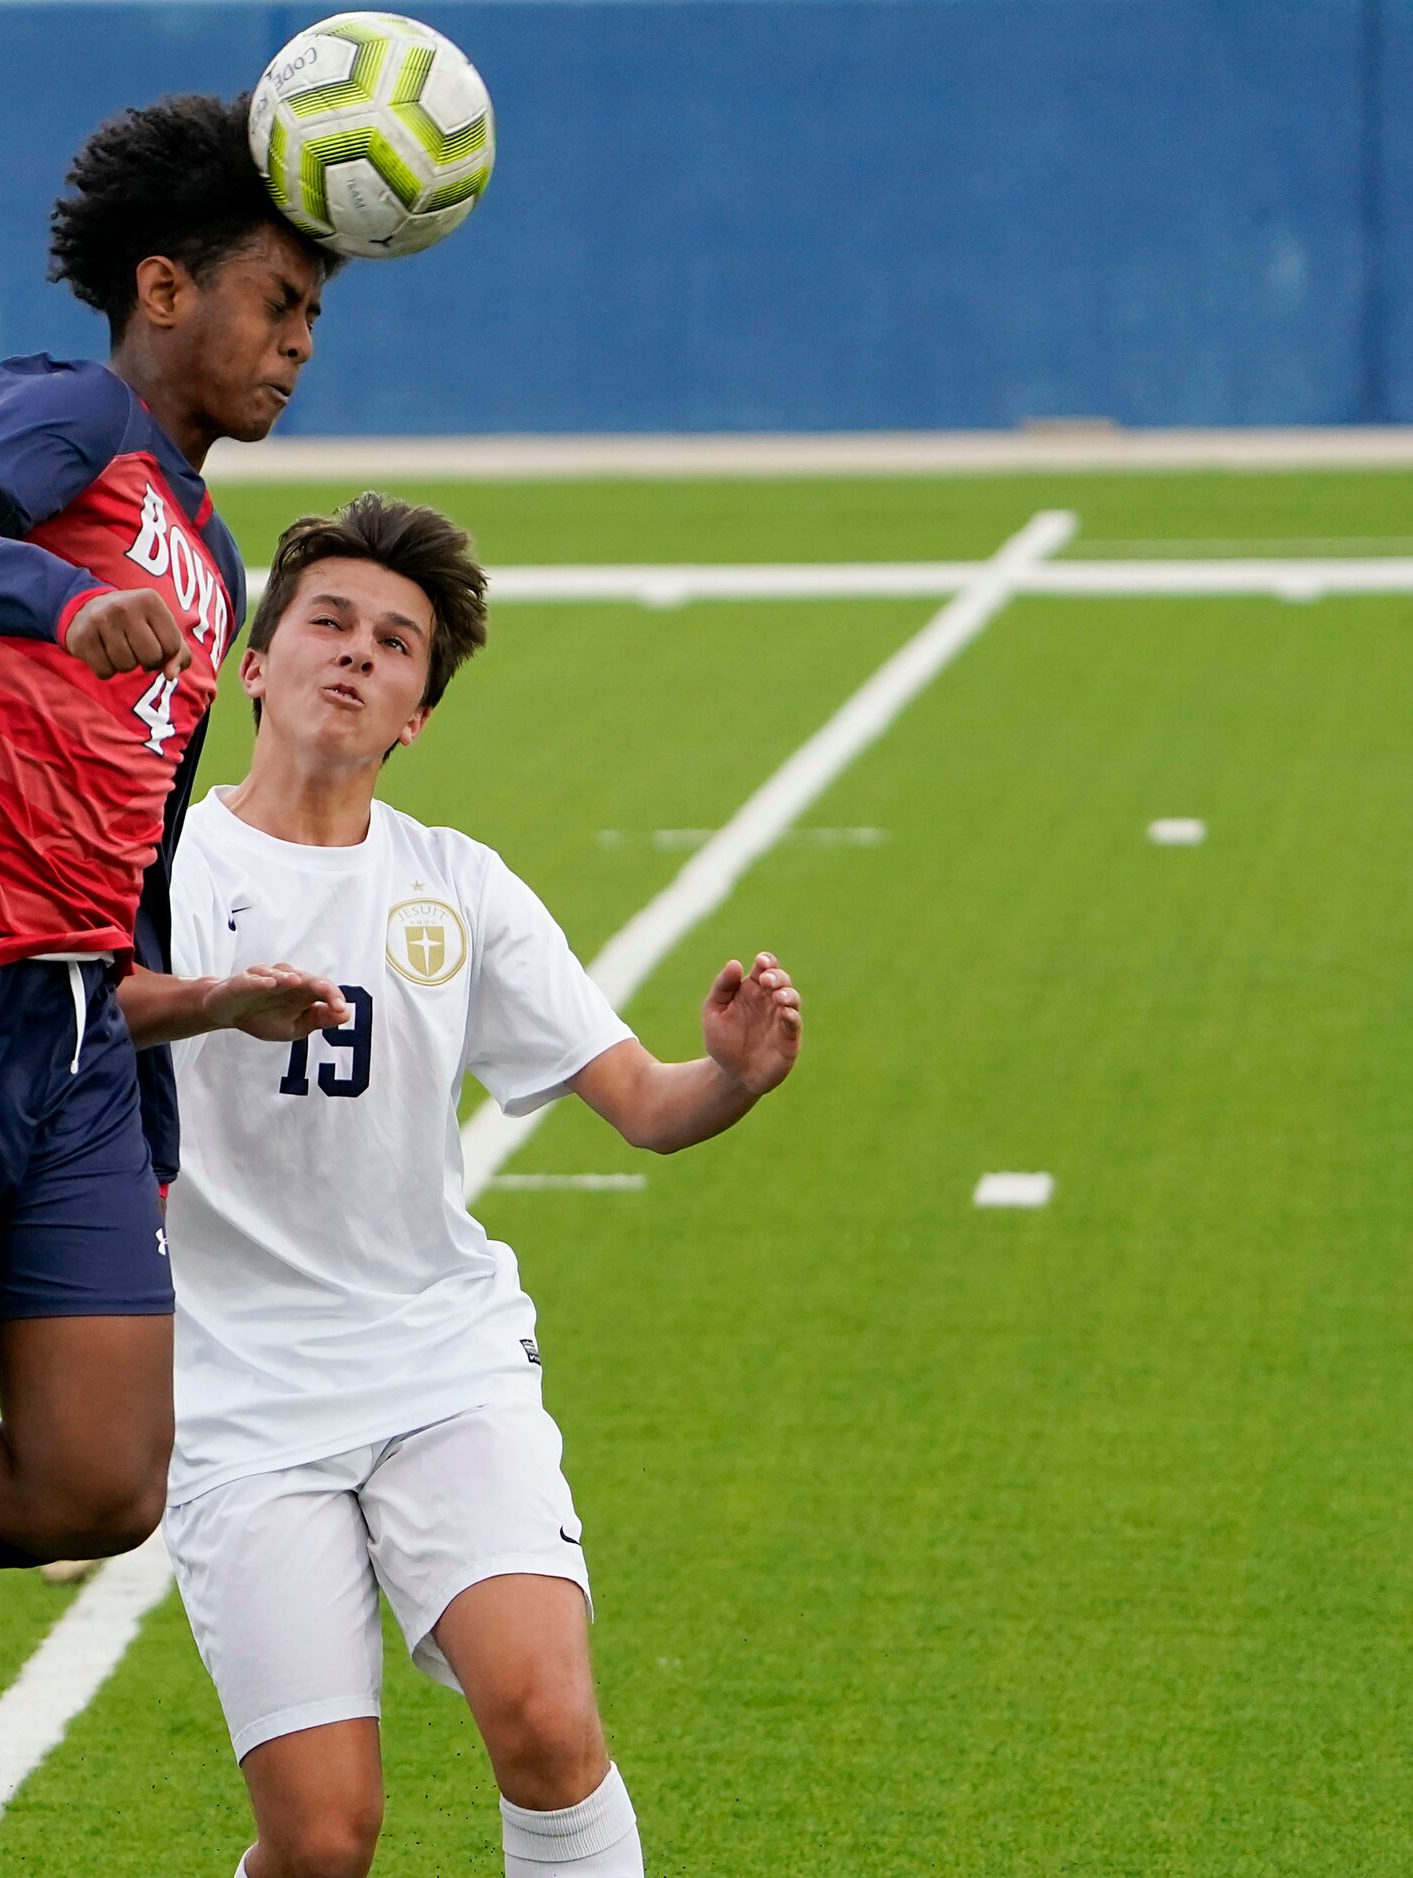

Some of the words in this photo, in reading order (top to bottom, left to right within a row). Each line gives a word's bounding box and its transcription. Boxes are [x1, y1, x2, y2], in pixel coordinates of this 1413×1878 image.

[274, 46, 318, 92] CODE
[125, 482, 229, 673] BOYD
[132, 671, 179, 757] 4
[398, 905, 448, 921] JESUIT
[279, 984, 374, 1098] 19
